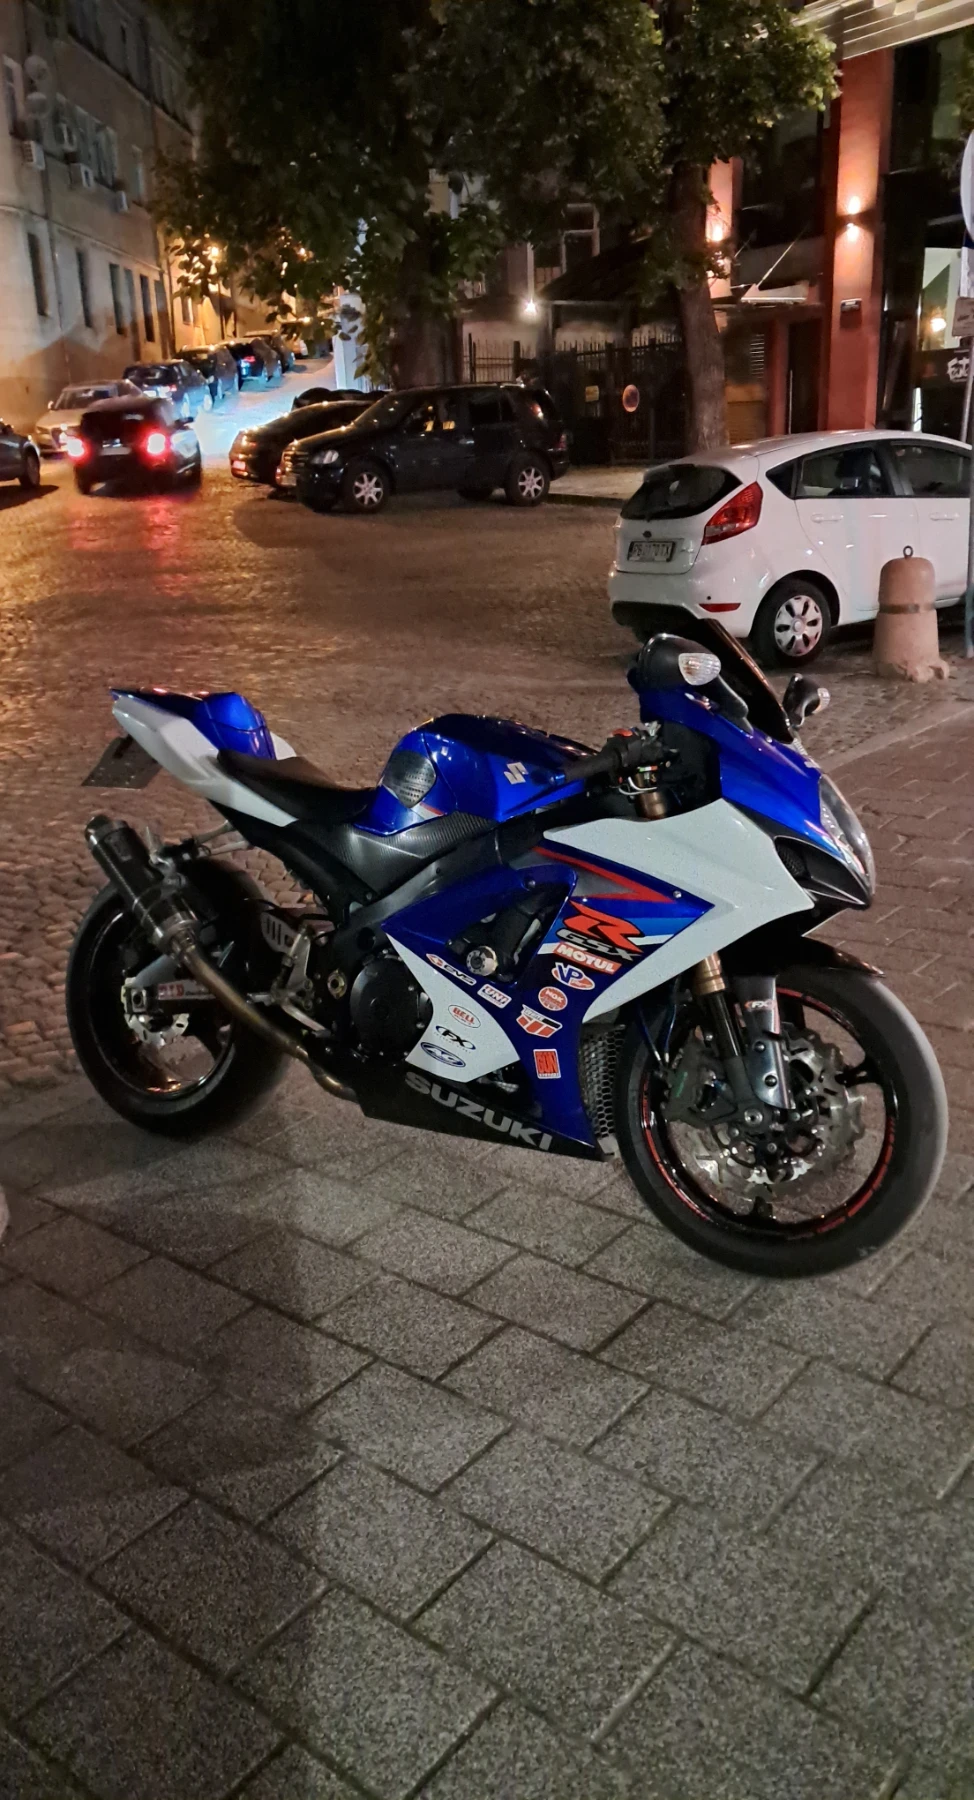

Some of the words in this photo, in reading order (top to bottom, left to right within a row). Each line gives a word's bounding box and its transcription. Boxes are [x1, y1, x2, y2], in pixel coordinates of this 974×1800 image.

[557, 944, 615, 973] MOTUL
[555, 962, 584, 984] VP
[452, 1007, 475, 1024] BELL
[405, 1071, 553, 1151] SUZUKI
